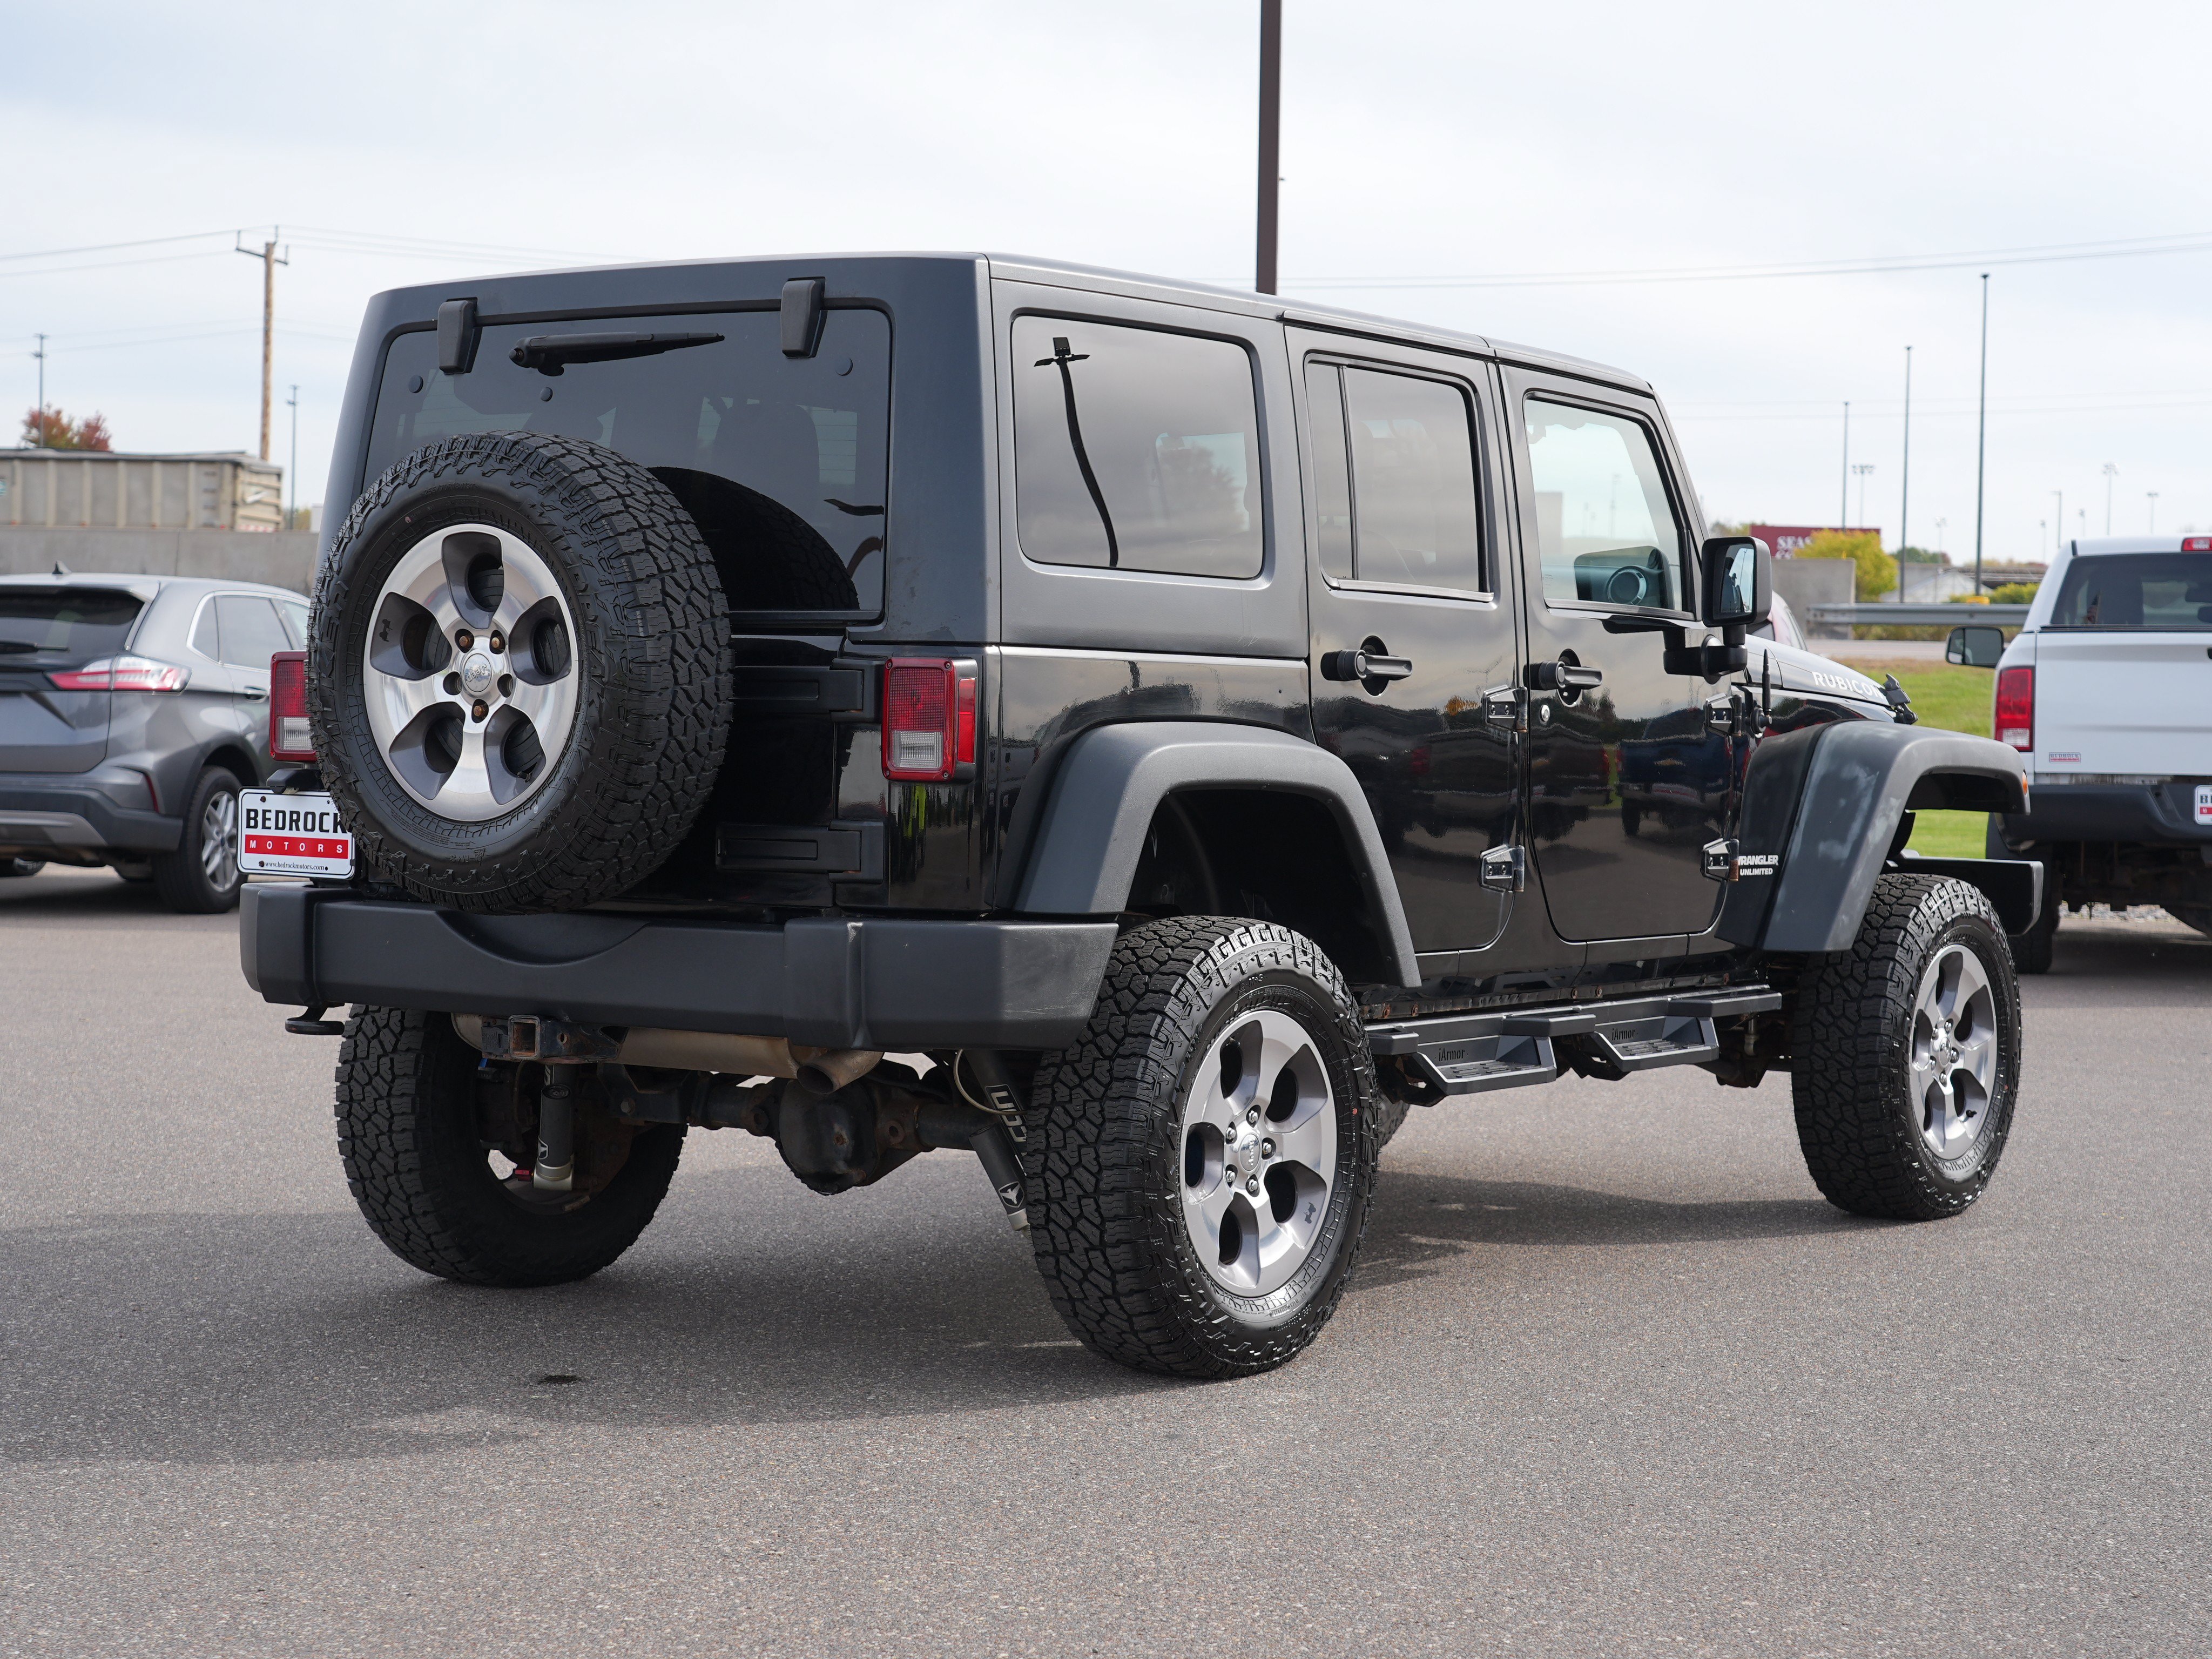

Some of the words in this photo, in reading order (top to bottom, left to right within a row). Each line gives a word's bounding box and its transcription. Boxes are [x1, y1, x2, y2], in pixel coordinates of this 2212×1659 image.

[467, 664, 488, 683] Jeep
[1811, 671, 1885, 700] RUBICON
[246, 808, 347, 834] BEDROCK
[249, 840, 343, 854] MOTORS
[265, 861, 325, 871] www.bedrockmotors.com
[1739, 867, 1773, 876] UNLIMITED
[1611, 1028, 1635, 1041] iArmor
[1438, 1047, 1466, 1062] iArmor
